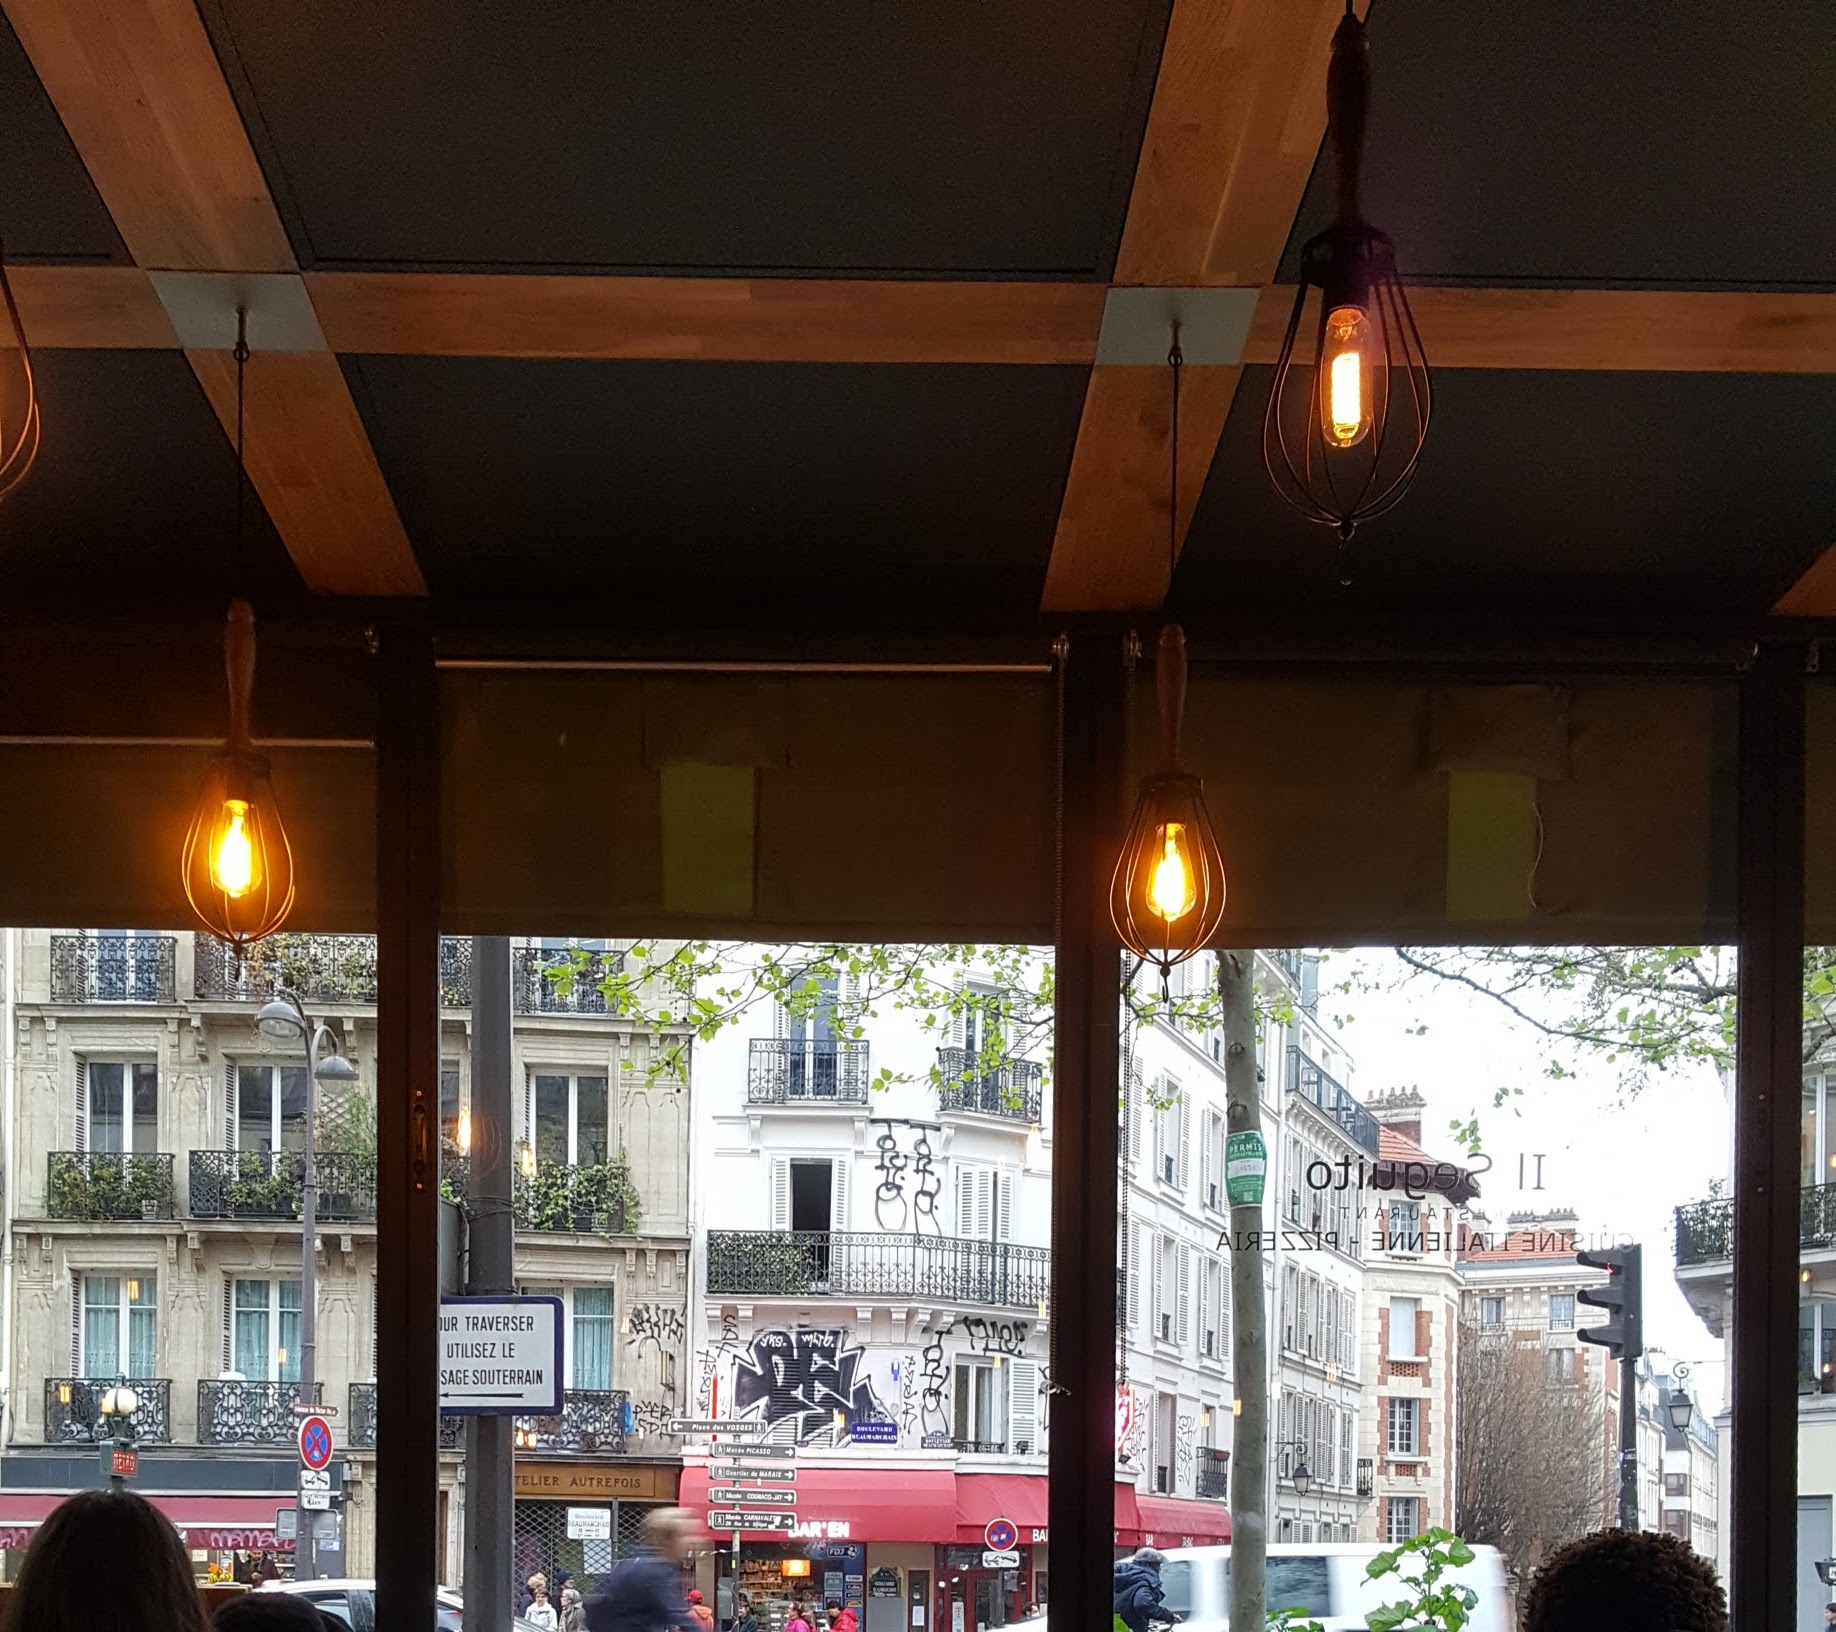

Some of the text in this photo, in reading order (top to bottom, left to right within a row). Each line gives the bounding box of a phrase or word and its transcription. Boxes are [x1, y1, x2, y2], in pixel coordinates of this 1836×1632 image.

[1229, 1143, 1262, 1154] PERMIS
[465, 1316, 534, 1331] TRAVERSER
[447, 1343, 515, 1358] UTILISEZ LE
[440, 1369, 543, 1385] SAGE SOUTERRAIN
[692, 1423, 710, 1431] Place
[712, 1423, 724, 1431] des
[746, 1447, 771, 1455] PICASSO
[726, 1469, 749, 1477] Quartier
[514, 1475, 641, 1488] TELIER AUTREFOIS
